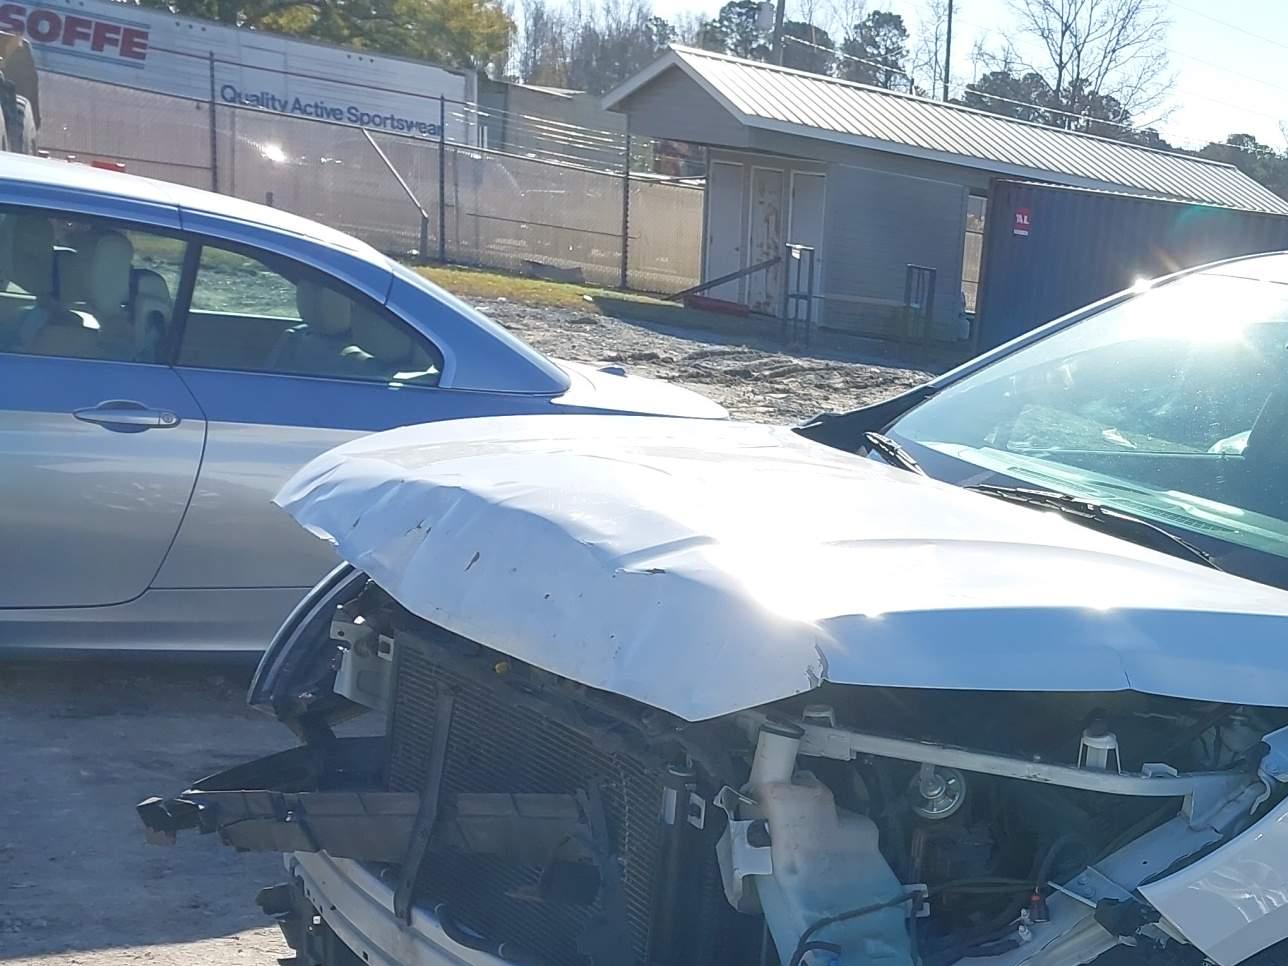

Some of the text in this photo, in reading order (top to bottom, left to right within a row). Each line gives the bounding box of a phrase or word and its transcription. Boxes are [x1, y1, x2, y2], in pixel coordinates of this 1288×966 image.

[0, 3, 149, 60] SOFFE
[220, 84, 443, 137] Quality Active Sportswear
